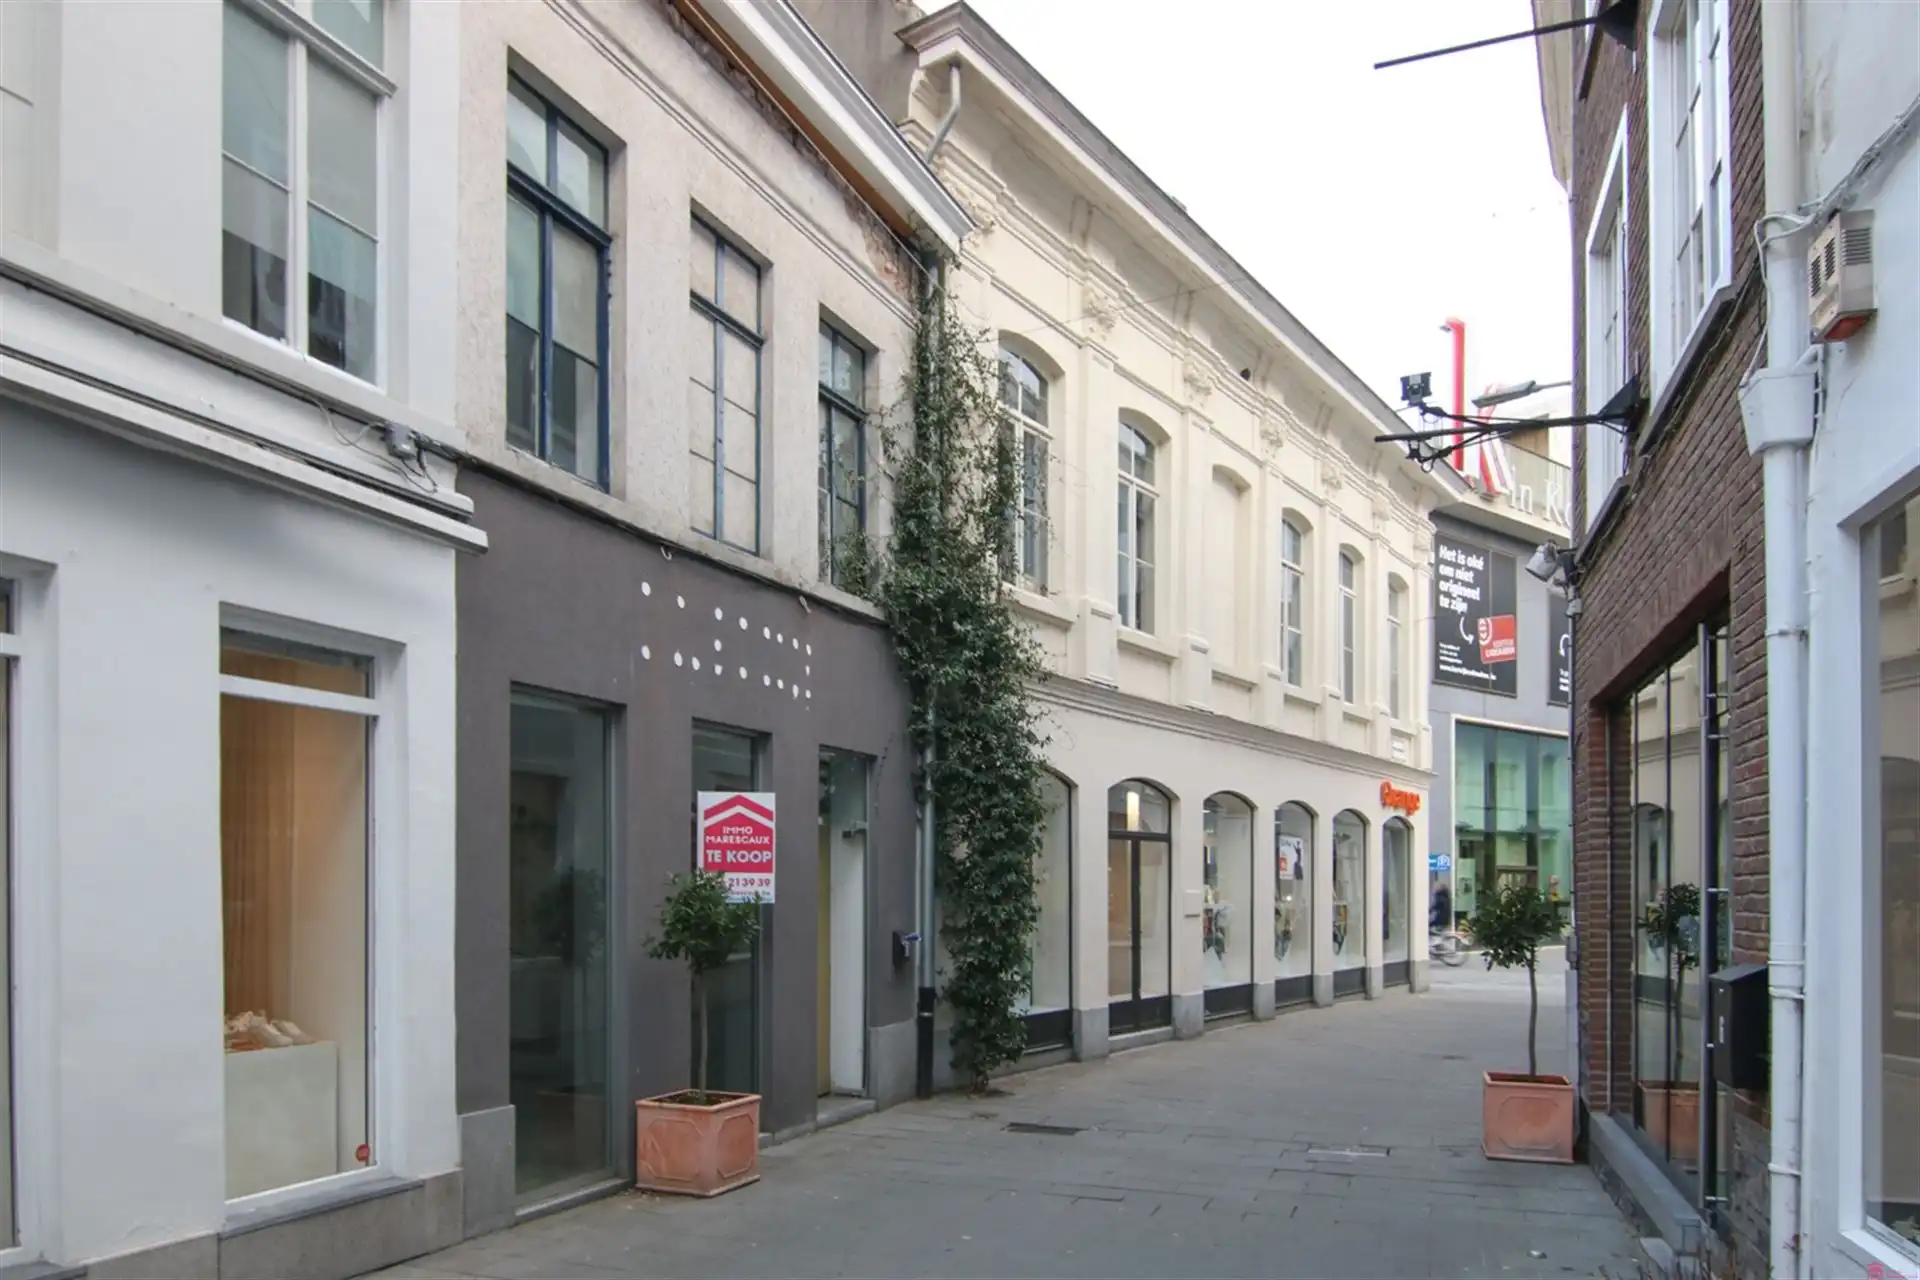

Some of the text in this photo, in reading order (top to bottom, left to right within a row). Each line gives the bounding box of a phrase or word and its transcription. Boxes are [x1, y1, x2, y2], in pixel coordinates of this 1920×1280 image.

[722, 826, 753, 835] IMMO
[705, 835, 770, 845] MARESCAUX
[706, 850, 772, 863] TE KOOP
[743, 878, 756, 888] 39
[758, 878, 771, 888] 39
